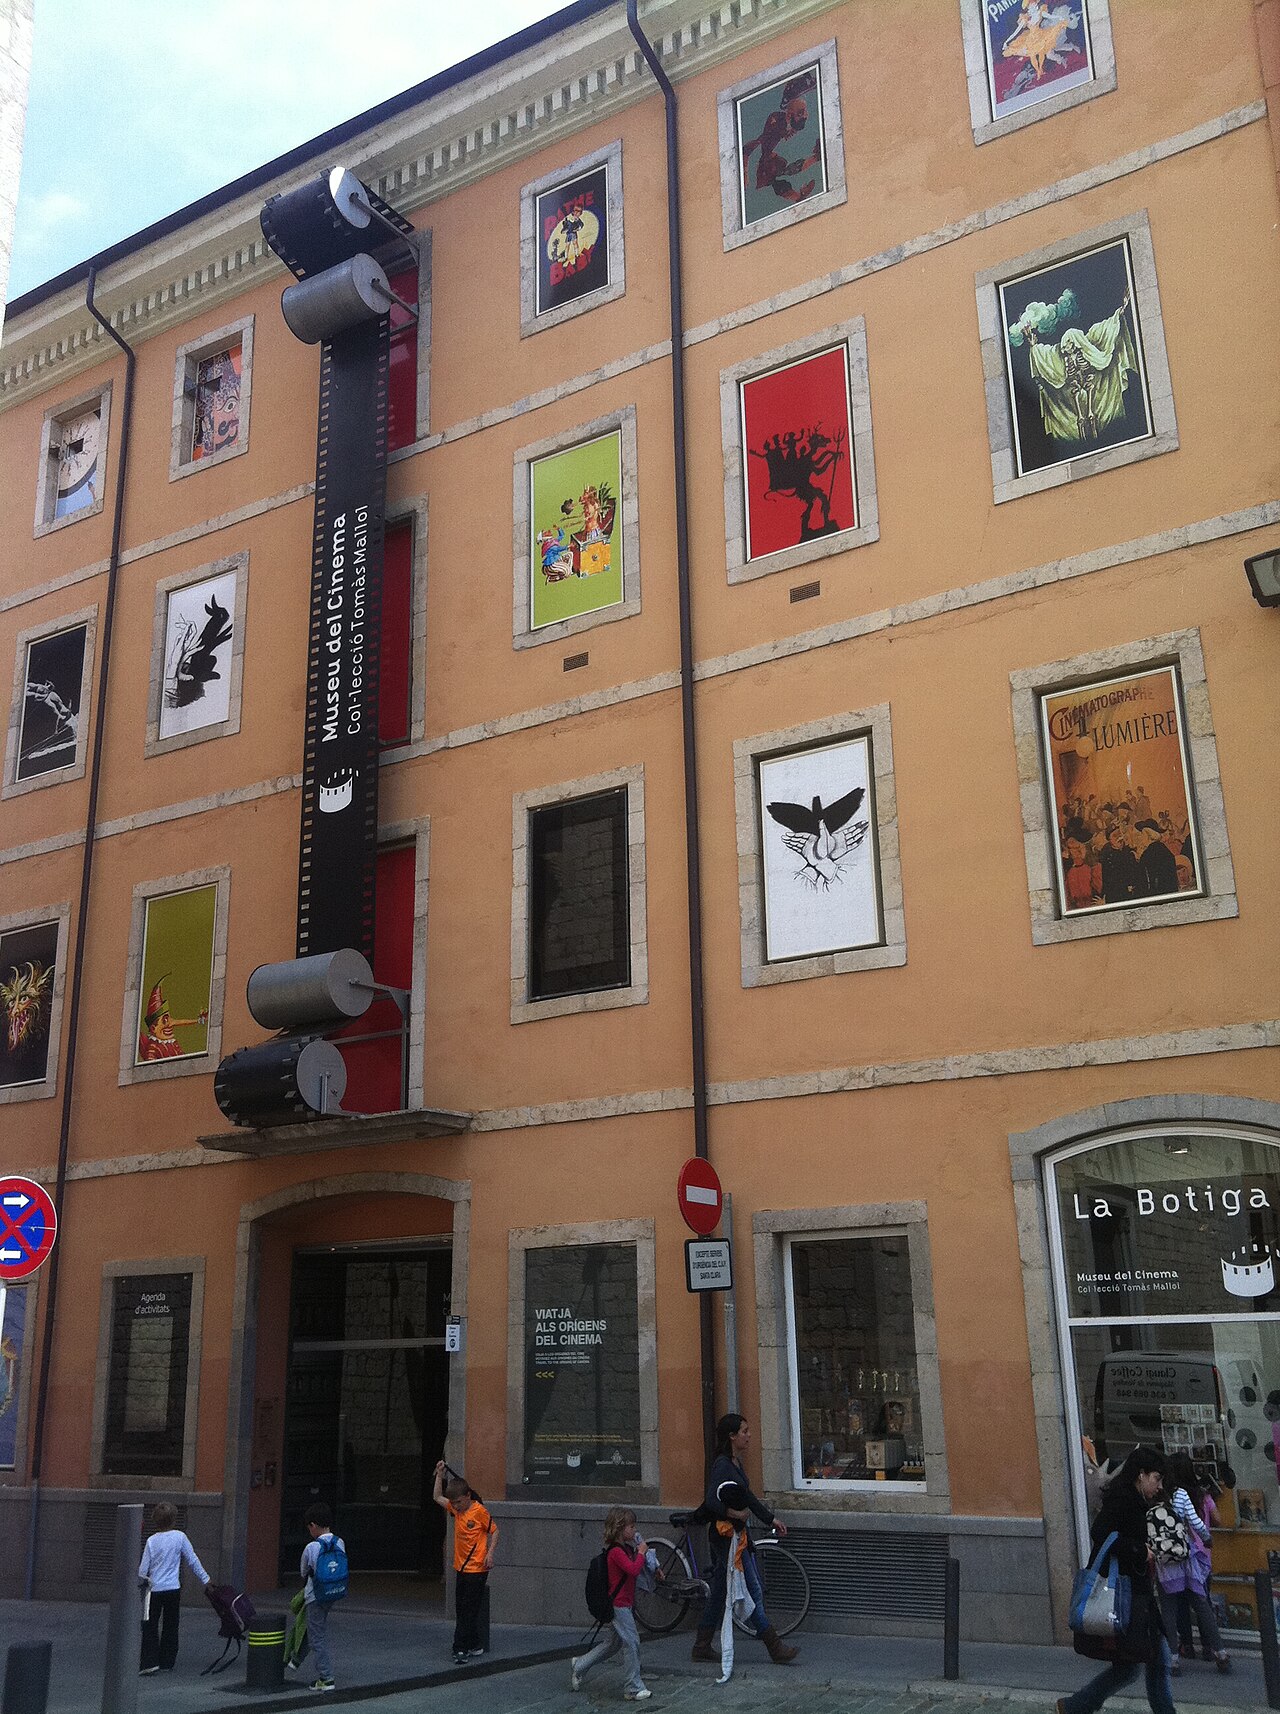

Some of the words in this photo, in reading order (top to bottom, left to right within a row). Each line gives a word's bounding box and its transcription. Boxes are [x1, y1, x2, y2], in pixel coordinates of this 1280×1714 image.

[549, 244, 595, 287] BABY
[353, 505, 368, 565] Mallol
[327, 512, 346, 610] Cinema
[351, 565, 366, 632] Tomàs
[326, 613, 342, 653] del
[322, 658, 341, 742] Museu
[1092, 710, 1179, 752] LUMIÈRE
[1073, 1193, 1112, 1220] La
[1137, 1184, 1271, 1217] Botiga
[1077, 1272, 1112, 1283] Museu
[1114, 1270, 1132, 1281] del
[1135, 1269, 1179, 1280] Cinema
[1153, 1281, 1180, 1291] Mallol
[135, 1304, 170, 1314] d'activitats
[141, 1292, 166, 1303] Agenda
[535, 1307, 572, 1320] VIATJA
[535, 1321, 557, 1333] ALS
[559, 1318, 607, 1332] ORÍGENS
[535, 1334, 558, 1346] DEL
[559, 1333, 603, 1346] CINEMA
